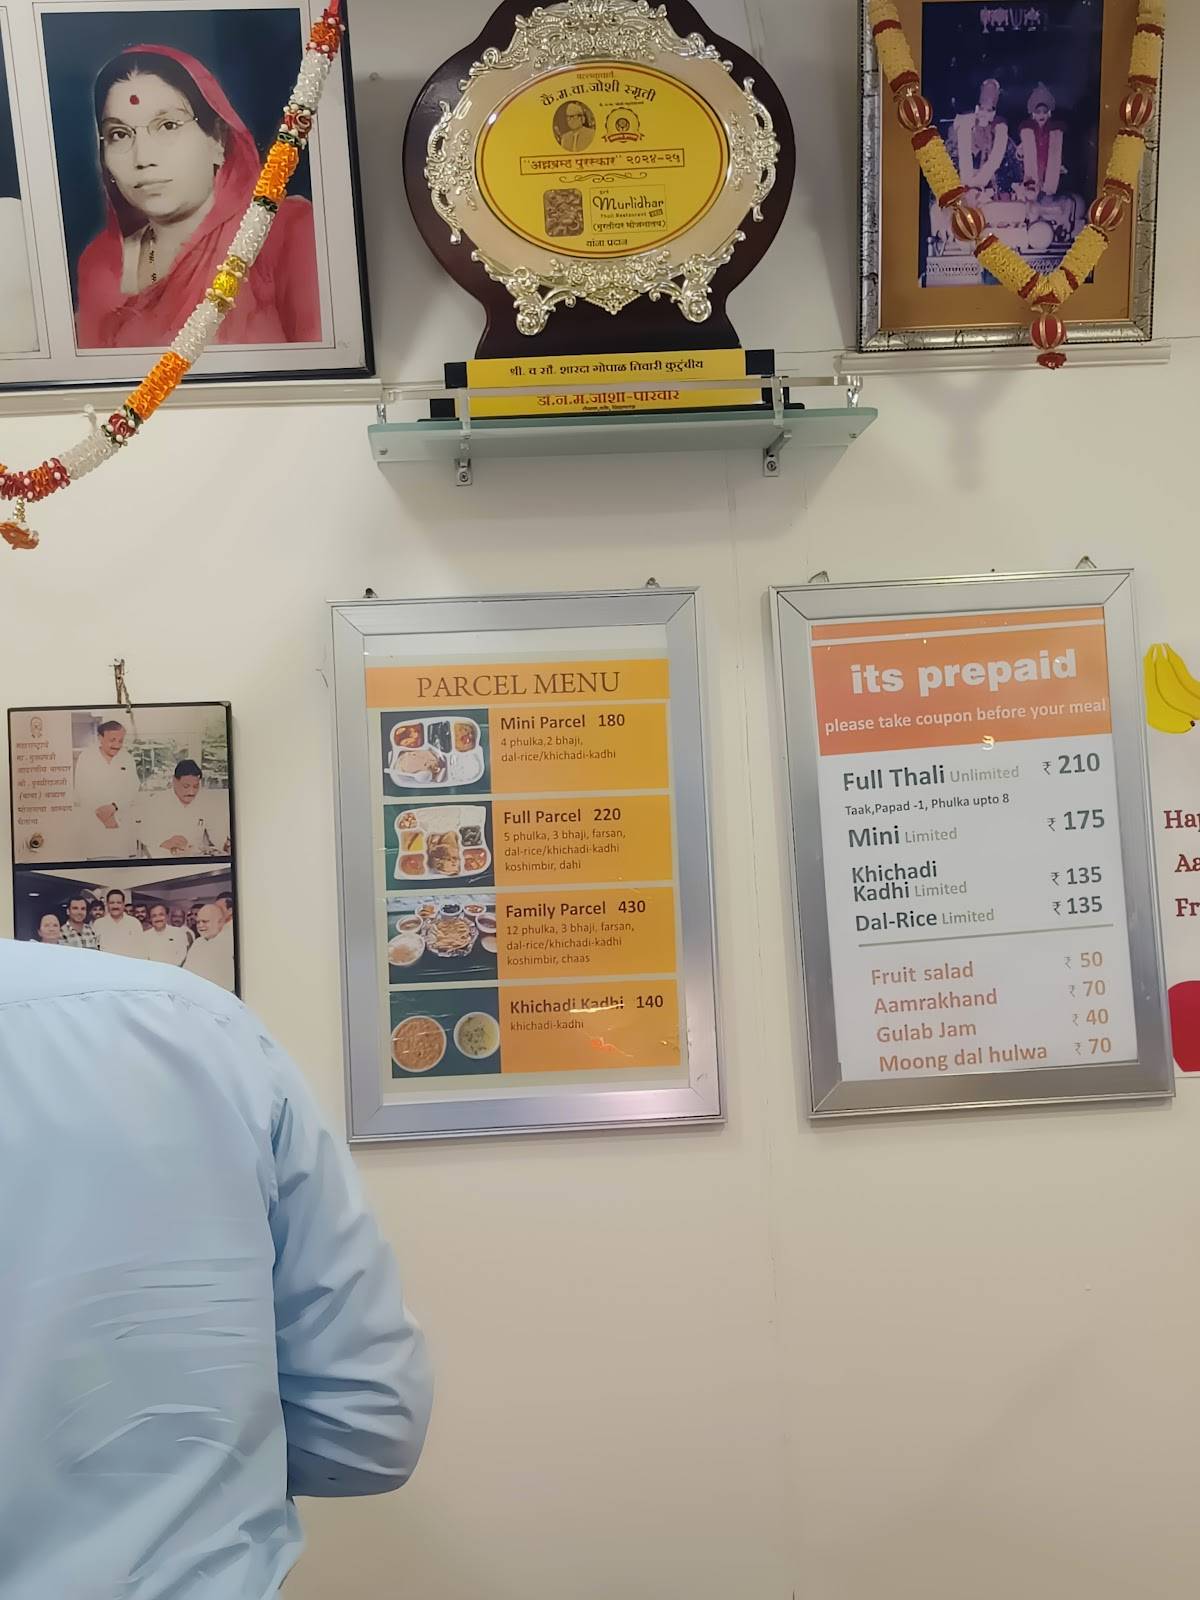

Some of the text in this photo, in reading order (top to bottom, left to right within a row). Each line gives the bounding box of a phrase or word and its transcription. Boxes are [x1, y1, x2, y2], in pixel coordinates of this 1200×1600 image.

[592, 195, 664, 210] Murlidhar
[560, 365, 589, 375] शारदा
[592, 362, 627, 373] गोपाळ
[630, 360, 662, 371] तिवारी
[850, 648, 1077, 697] its prepaid
[416, 671, 620, 698] PARCEL MENU
[501, 714, 625, 730] Mini Parcel 180
[825, 698, 1107, 736] please take coupon before your meal
[501, 738, 507, 746] 4
[501, 749, 616, 762] dal-rice/khichadi-kadhi
[843, 769, 883, 792] Full
[889, 764, 945, 788] Thali
[950, 765, 1020, 783] Unlimited
[1058, 752, 1100, 774] 210
[931, 797, 970, 809] Phulka
[973, 795, 999, 806] upto
[1002, 793, 1010, 803] 8
[504, 808, 621, 824] Full Parcel 220
[504, 828, 626, 842] 5 phulka, 3 bhaji, farsan,
[848, 825, 900, 848] Mini
[905, 827, 958, 844] Limited
[1063, 808, 1105, 831] 175
[504, 843, 620, 857] dal-rice/khichadi-kadhi
[505, 860, 581, 872] koshimbir, dahi
[852, 860, 937, 884] Khichadi
[853, 881, 910, 902] Kadhi
[914, 881, 967, 897] Limited
[1066, 866, 1102, 885] 135
[506, 900, 646, 919] Family Parcel 430
[855, 910, 938, 932] Dal-Rice
[942, 908, 995, 925] Limited
[1066, 896, 1103, 915] 135
[507, 925, 518, 935] 12
[522, 925, 559, 936] phulka,
[561, 924, 567, 933] 3
[601, 922, 635, 932] farsan,
[506, 937, 622, 951] dal-rice/khichadi-kadhi
[507, 953, 590, 966] koshimbir, chaas
[871, 966, 917, 985] Fruit
[923, 961, 974, 981] salad
[1080, 951, 1103, 968] 50
[510, 995, 664, 1014] Khichadi Kadhi 140
[874, 988, 998, 1014] Aamrakhand
[1082, 979, 1106, 997] 70
[510, 1019, 584, 1032] khichadi-kadhi
[876, 1022, 933, 1043] Gulab
[938, 1022, 977, 1038] Jam
[1086, 1008, 1109, 1025] 40
[879, 1055, 948, 1072] Moong
[954, 1047, 983, 1066] dal
[989, 1044, 1047, 1063] hulwa
[1088, 1037, 1112, 1055] 70
